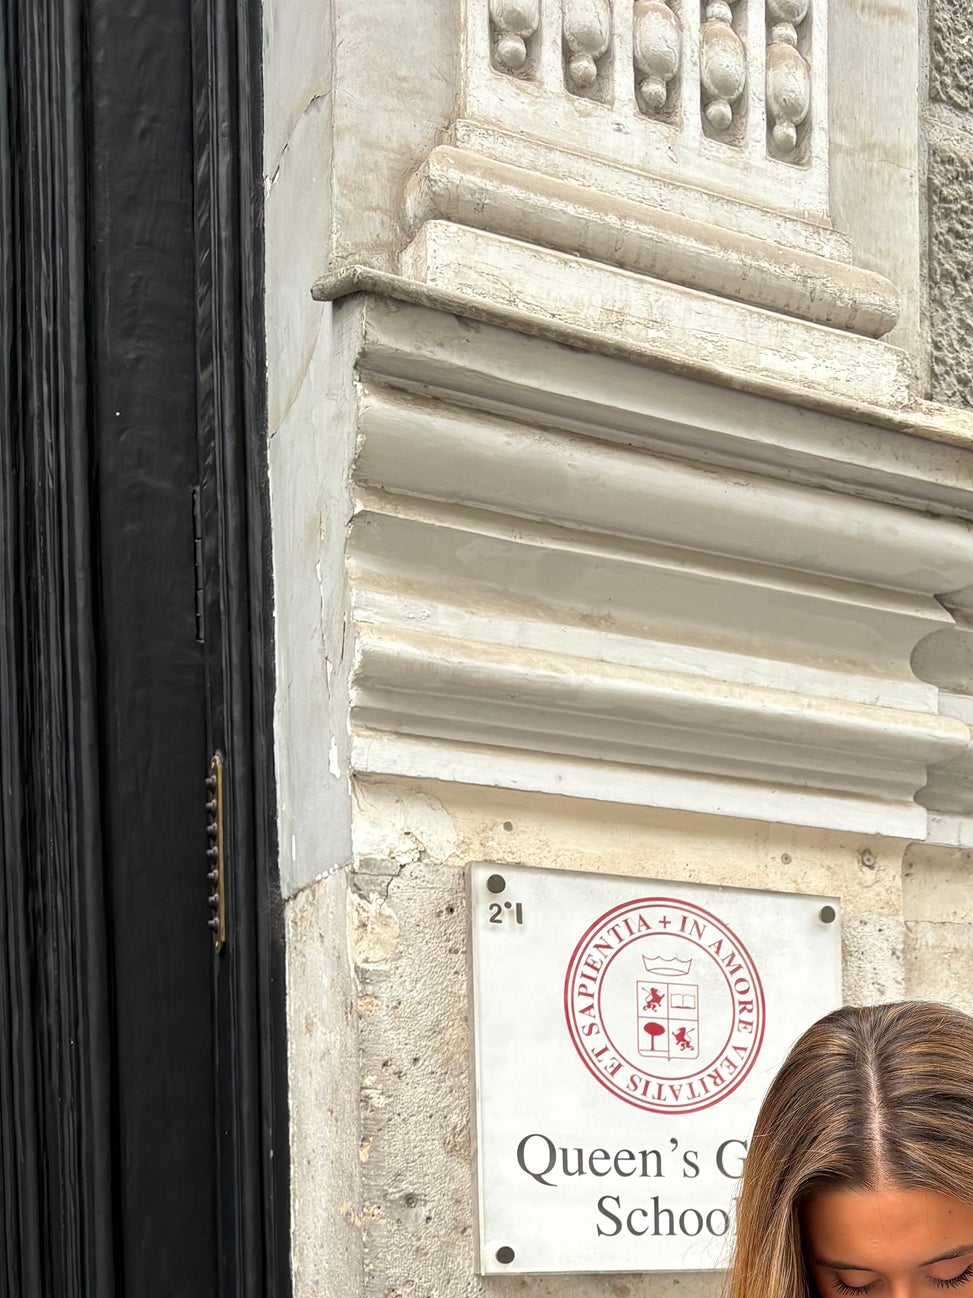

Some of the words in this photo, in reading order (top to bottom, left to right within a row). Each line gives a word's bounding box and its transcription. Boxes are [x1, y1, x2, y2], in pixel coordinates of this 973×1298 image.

[679, 914, 707, 941] IN
[578, 913, 652, 1037] SAPIENTIA
[709, 938, 754, 1035] AMORE
[591, 1044, 625, 1079] ET
[626, 1045, 749, 1102] VERITATIS
[516, 1133, 700, 1187] Queen's
[596, 1195, 737, 1237] Schoo
